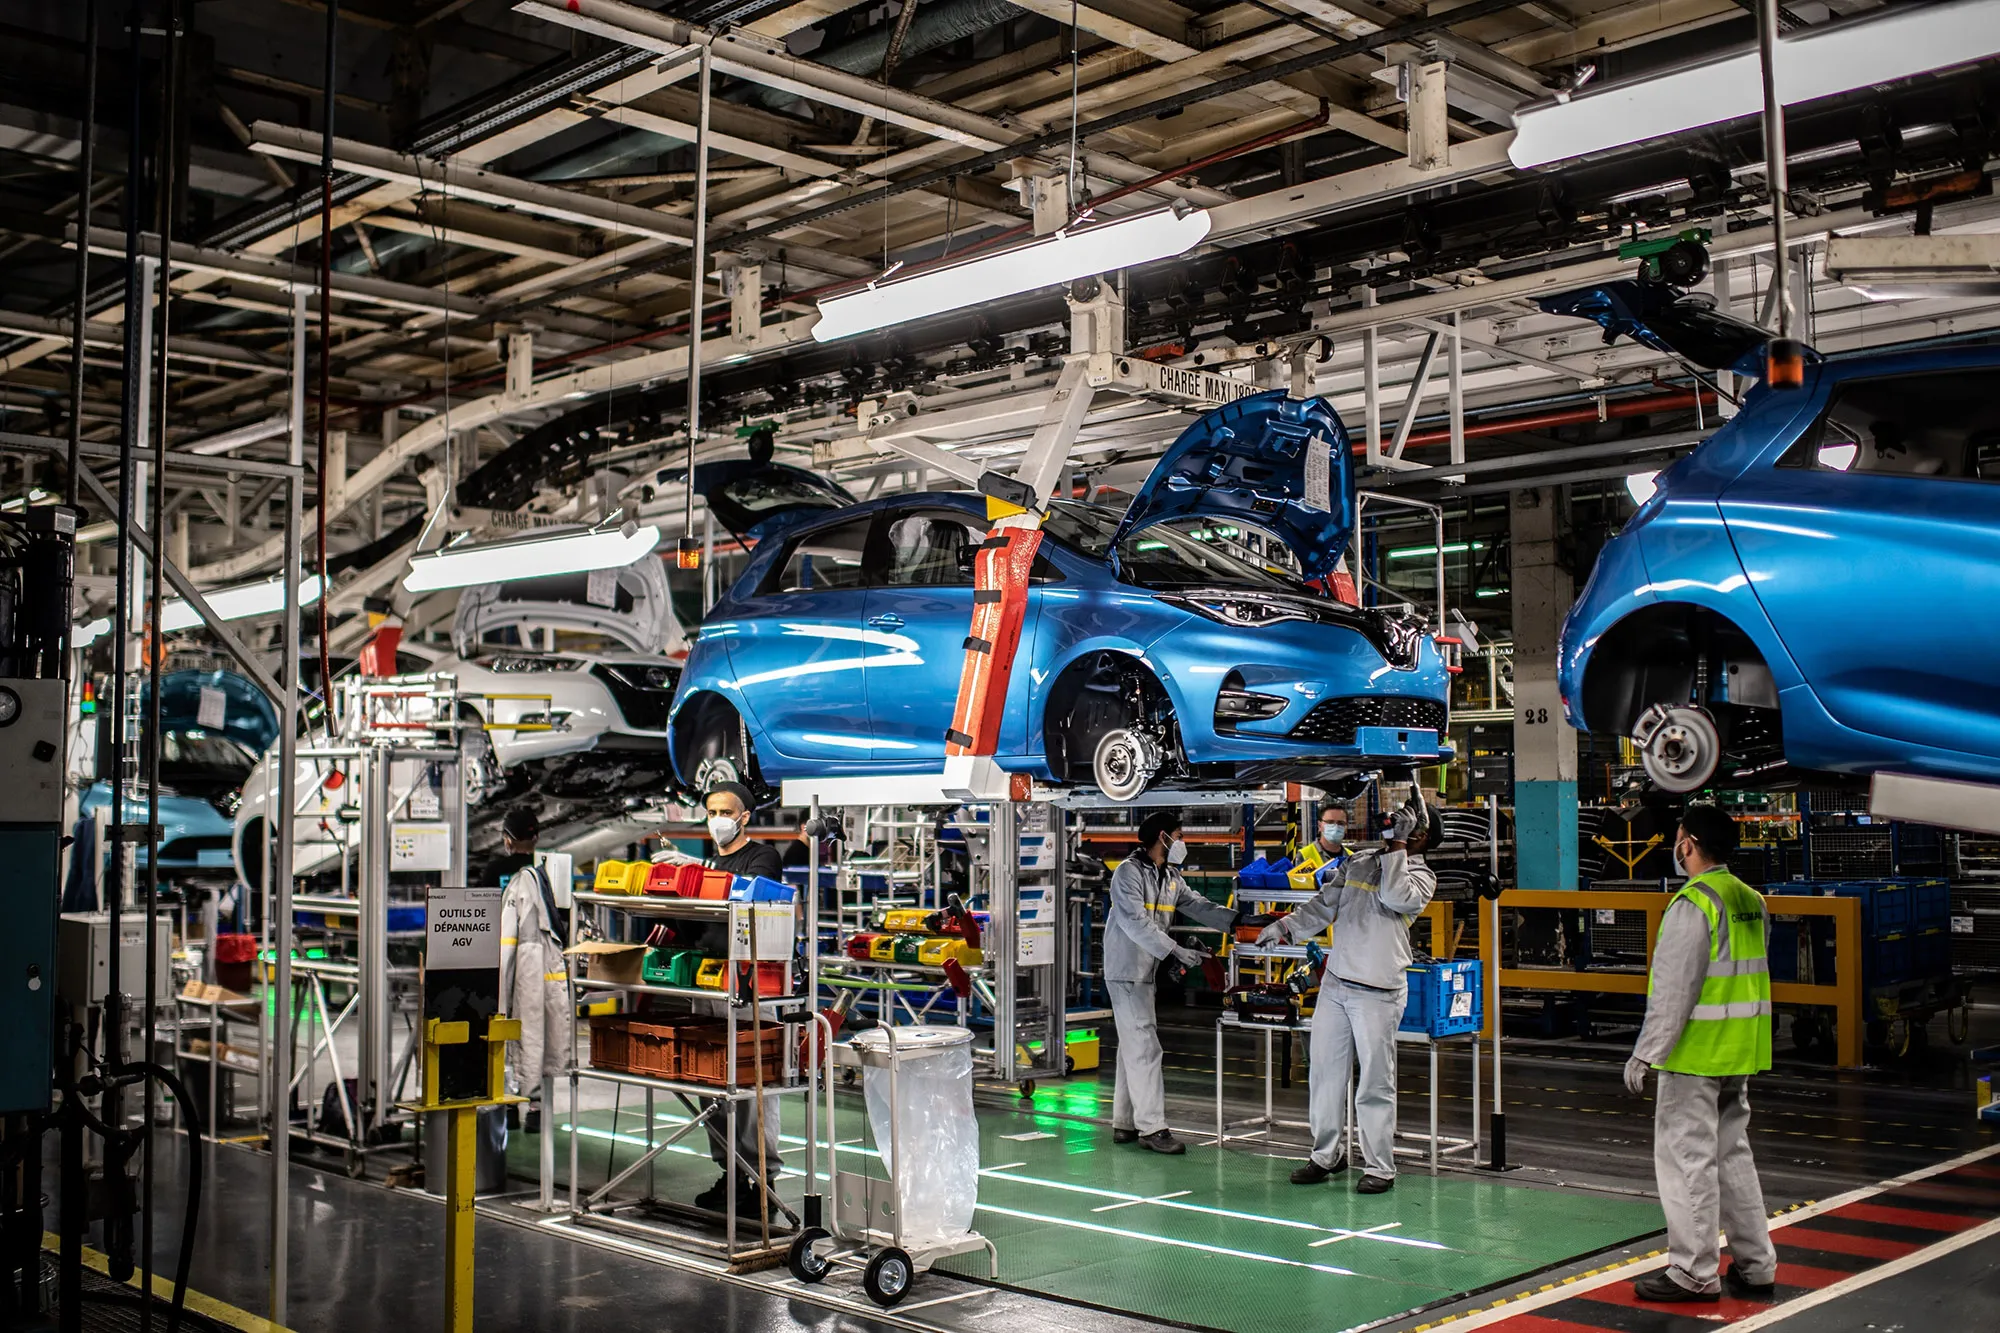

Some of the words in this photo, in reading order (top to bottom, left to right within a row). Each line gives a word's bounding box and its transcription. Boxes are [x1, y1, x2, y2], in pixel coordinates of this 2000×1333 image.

[1160, 366, 1200, 396] CHARGE
[1205, 377, 1230, 402] MAXI
[1235, 384, 1257, 399] 18
[491, 511, 528, 529] CHARGE
[1525, 708, 1548, 724] 28
[440, 909, 472, 918] OUTILS
[474, 909, 486, 917] DE
[434, 922, 491, 932] DÉPANNAGE
[452, 938, 473, 946] AGV
